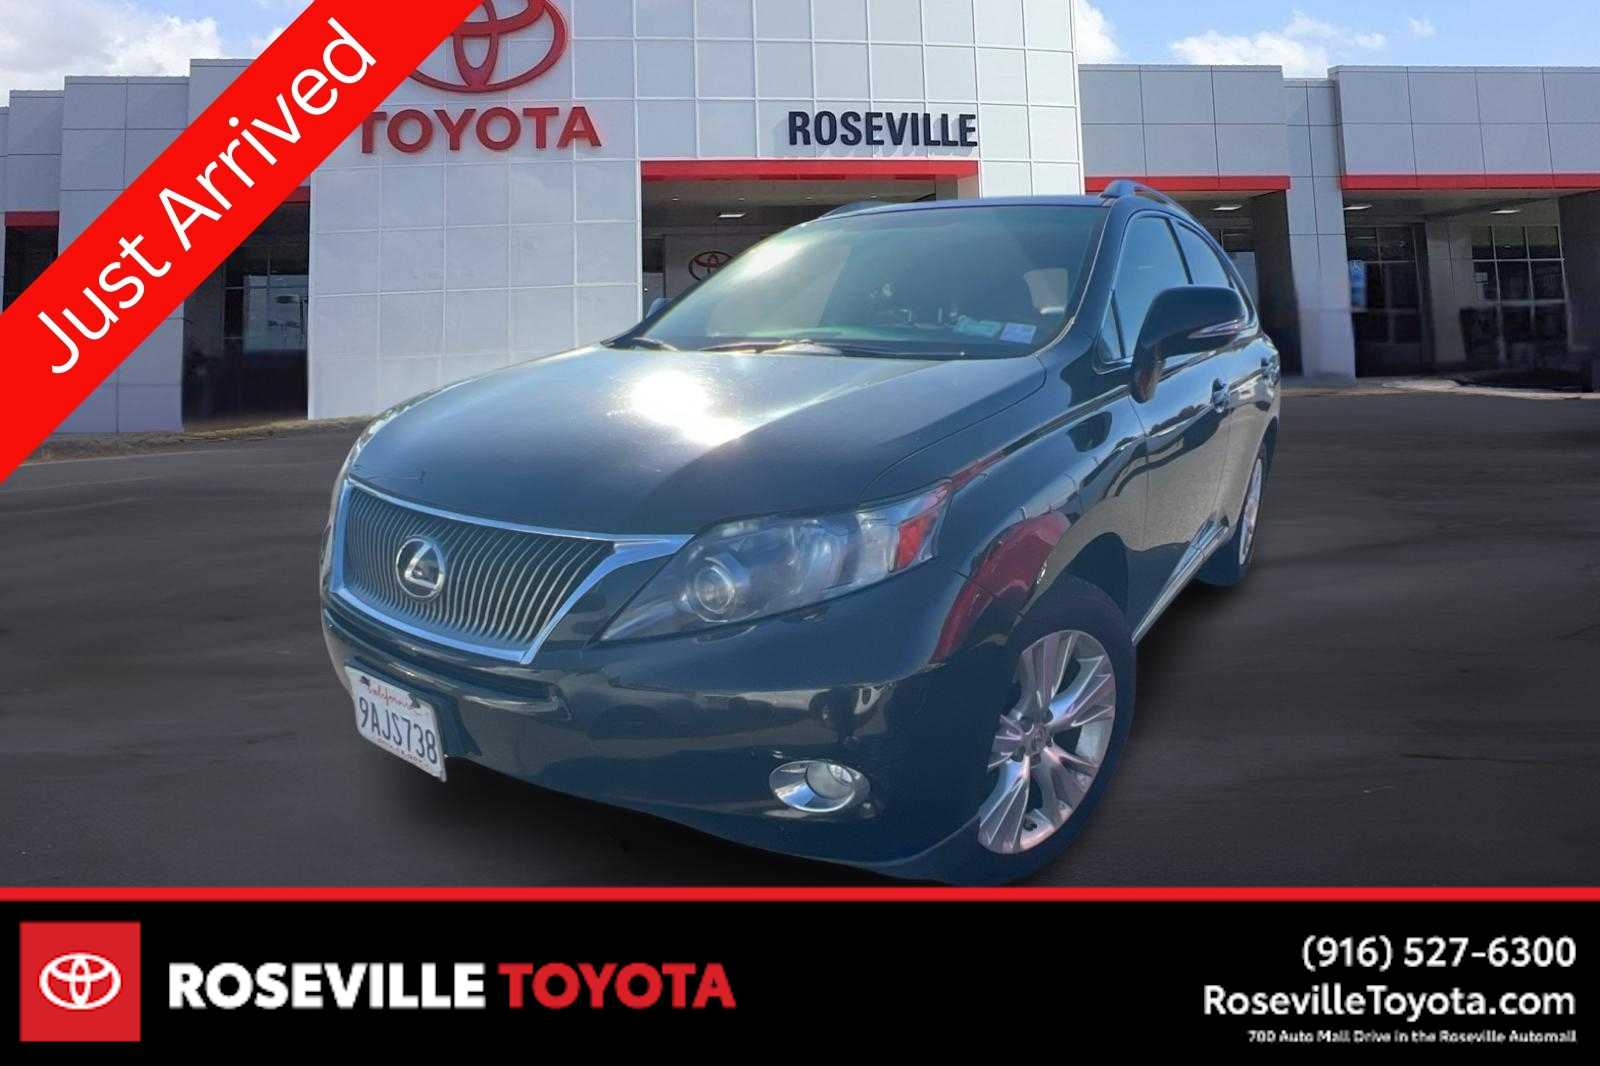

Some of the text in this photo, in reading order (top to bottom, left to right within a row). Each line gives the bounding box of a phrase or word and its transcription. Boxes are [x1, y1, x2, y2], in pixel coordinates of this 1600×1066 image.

[362, 106, 602, 154] TOYOTA
[788, 110, 978, 147] ROSEVILLE
[359, 696, 437, 764] 9AJS738
